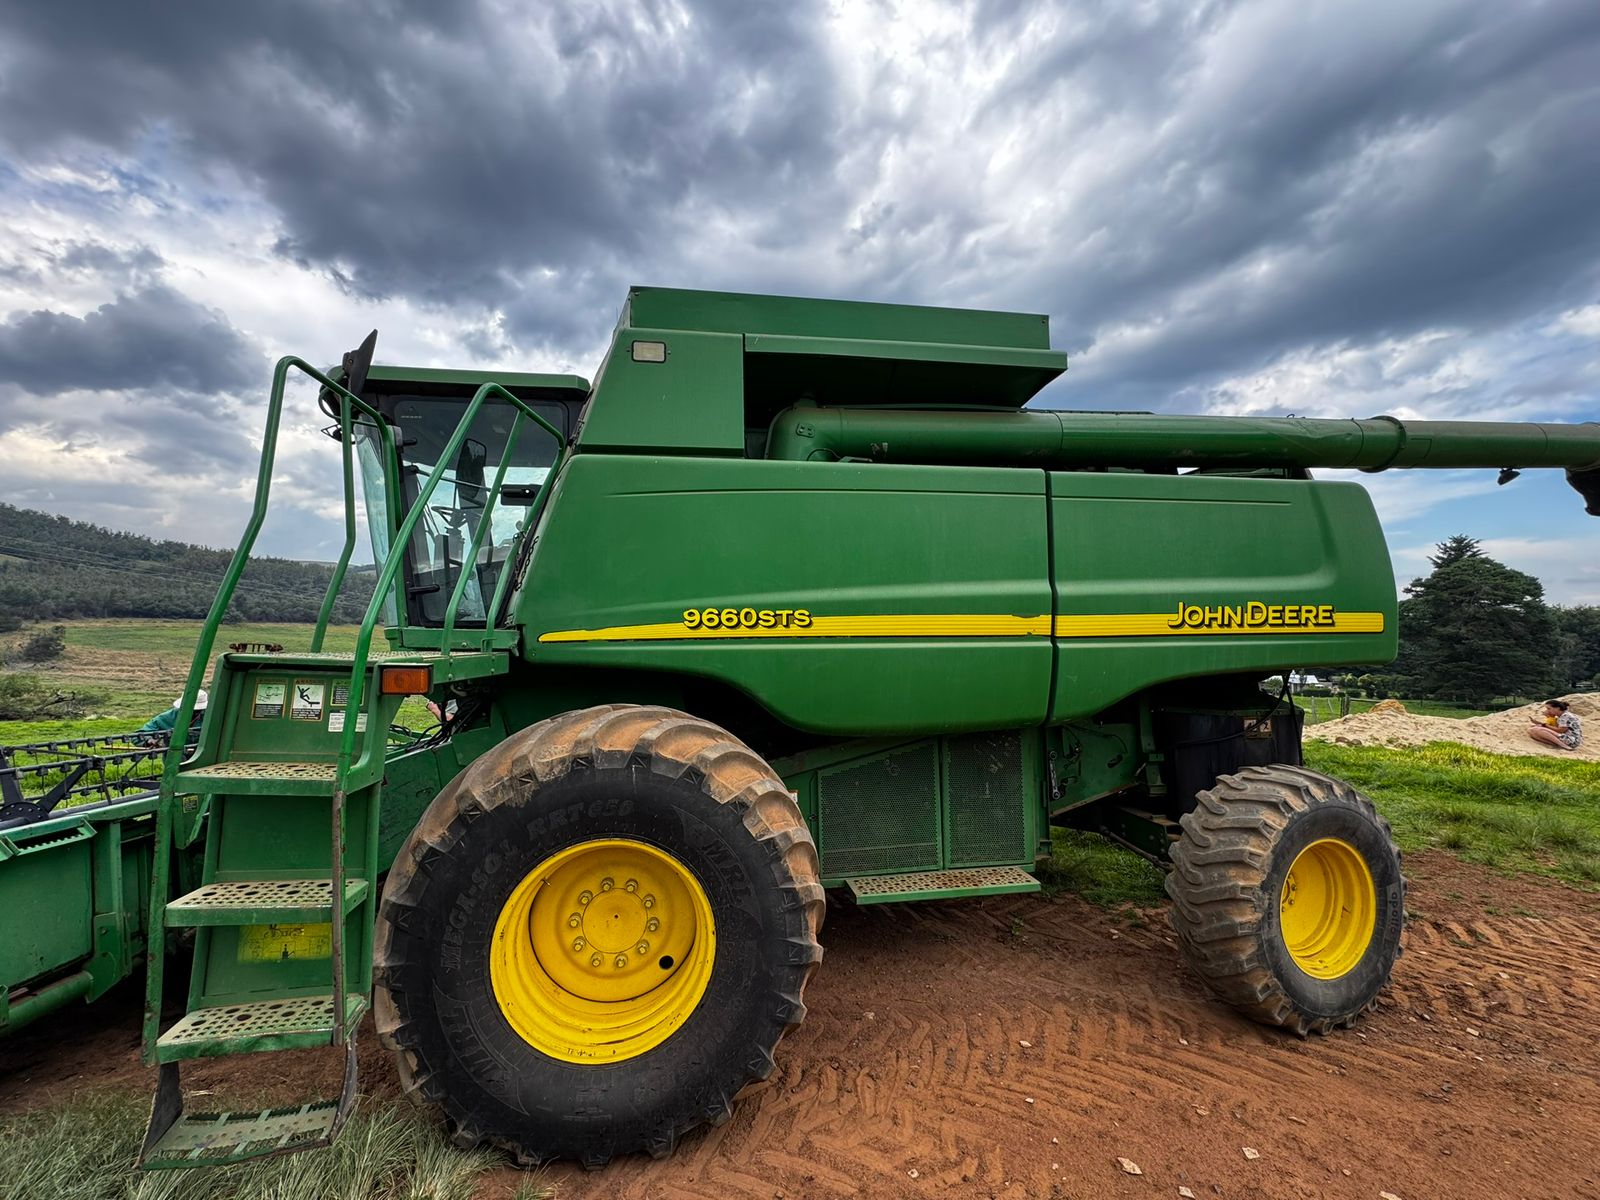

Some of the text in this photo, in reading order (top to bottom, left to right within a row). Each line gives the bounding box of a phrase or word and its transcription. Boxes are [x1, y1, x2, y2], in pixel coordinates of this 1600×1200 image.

[683, 607, 813, 628] 9660STS
[1168, 601, 1335, 627] JOHN DEERE
[1389, 892, 1399, 934] apollo
